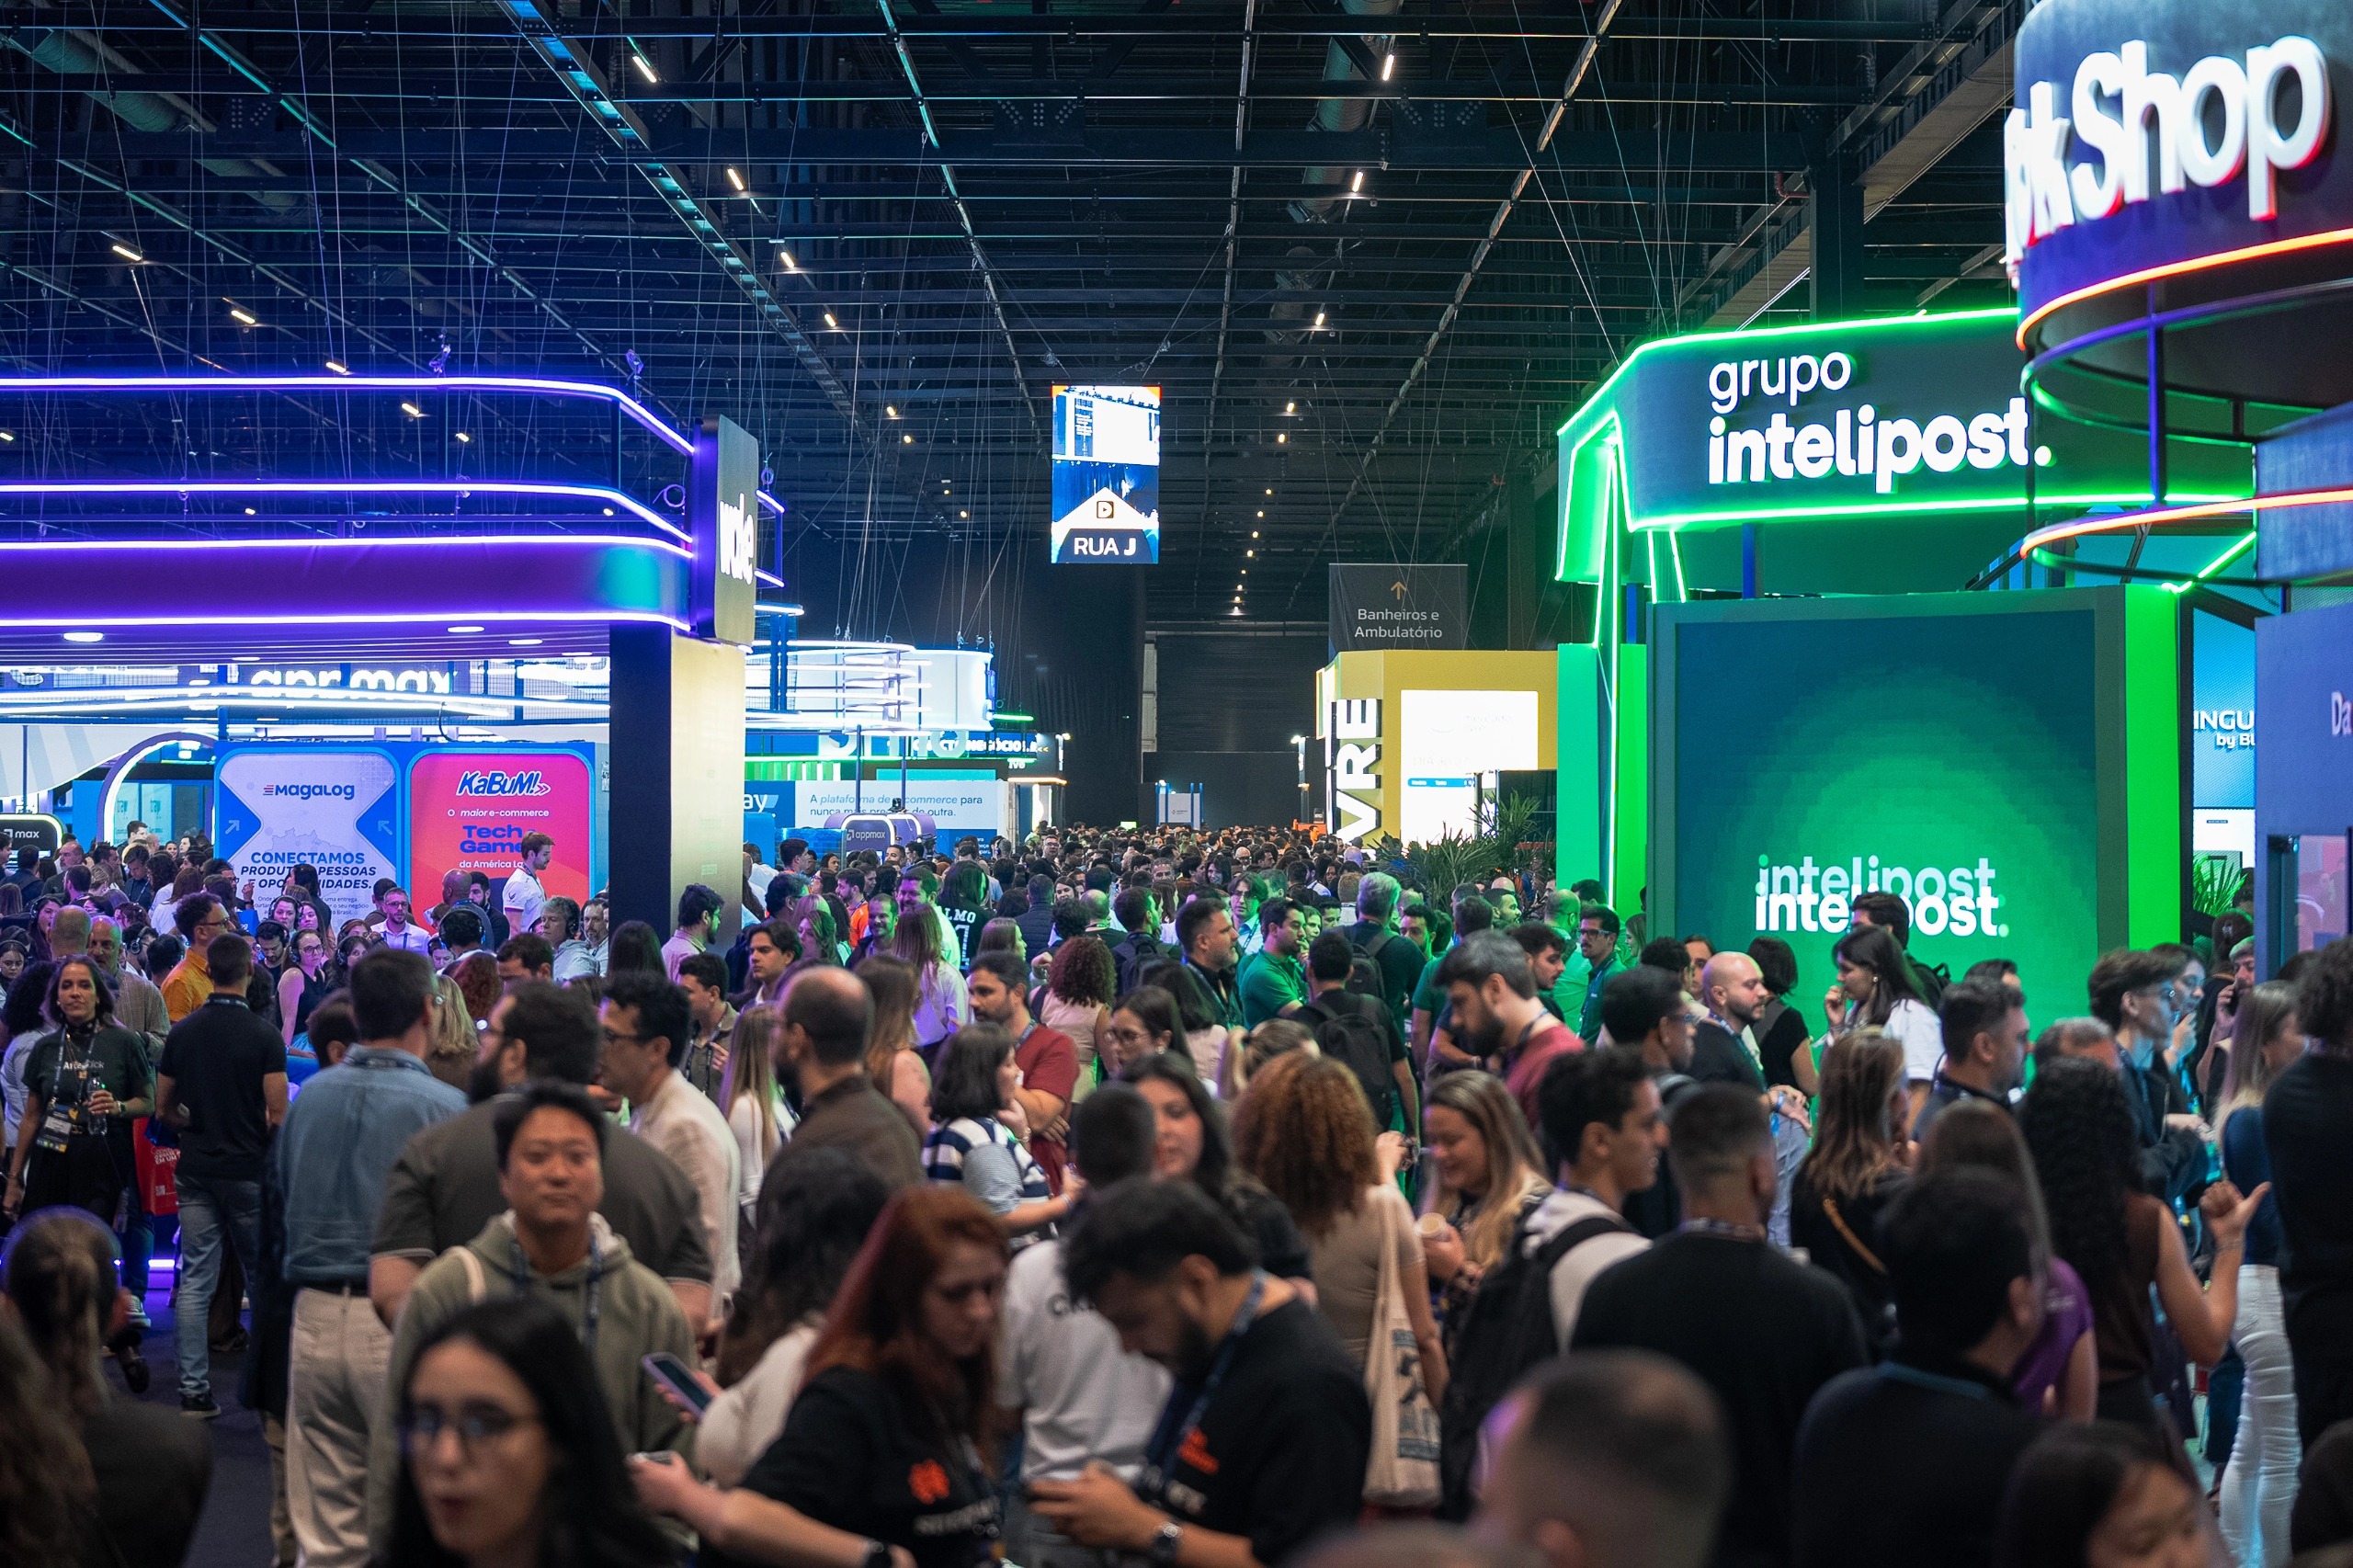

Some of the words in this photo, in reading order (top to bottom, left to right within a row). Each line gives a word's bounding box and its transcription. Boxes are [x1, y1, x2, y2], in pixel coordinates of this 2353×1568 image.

[1708, 351, 1852, 414] grupo
[1708, 396, 2052, 494] intelipost.
[1074, 537, 1119, 556] RUA
[1123, 537, 1137, 556] J
[1358, 608, 1427, 620] Banheiros
[1431, 612, 1439, 620] e
[1355, 626, 1443, 638] Ambulatório
[2216, 733, 2235, 748] by
[810, 795, 817, 803] A
[820, 794, 875, 807] platafoma
[878, 794, 890, 803] de
[905, 796, 958, 804] commerce
[961, 797, 983, 807] para
[448, 809, 455, 817] O
[460, 809, 488, 817] maior
[489, 809, 549, 817] e-commerce
[927, 808, 957, 816] outra.
[15, 830, 40, 838] max
[462, 824, 523, 838] Tech
[856, 831, 885, 841] appmax
[251, 851, 366, 864] CONECTAMOS
[460, 859, 472, 869] da
[473, 859, 512, 869] América
[241, 866, 294, 876] PRODUT
[318, 866, 377, 876] PESSOAS
[1755, 881, 2010, 937] inteost.
